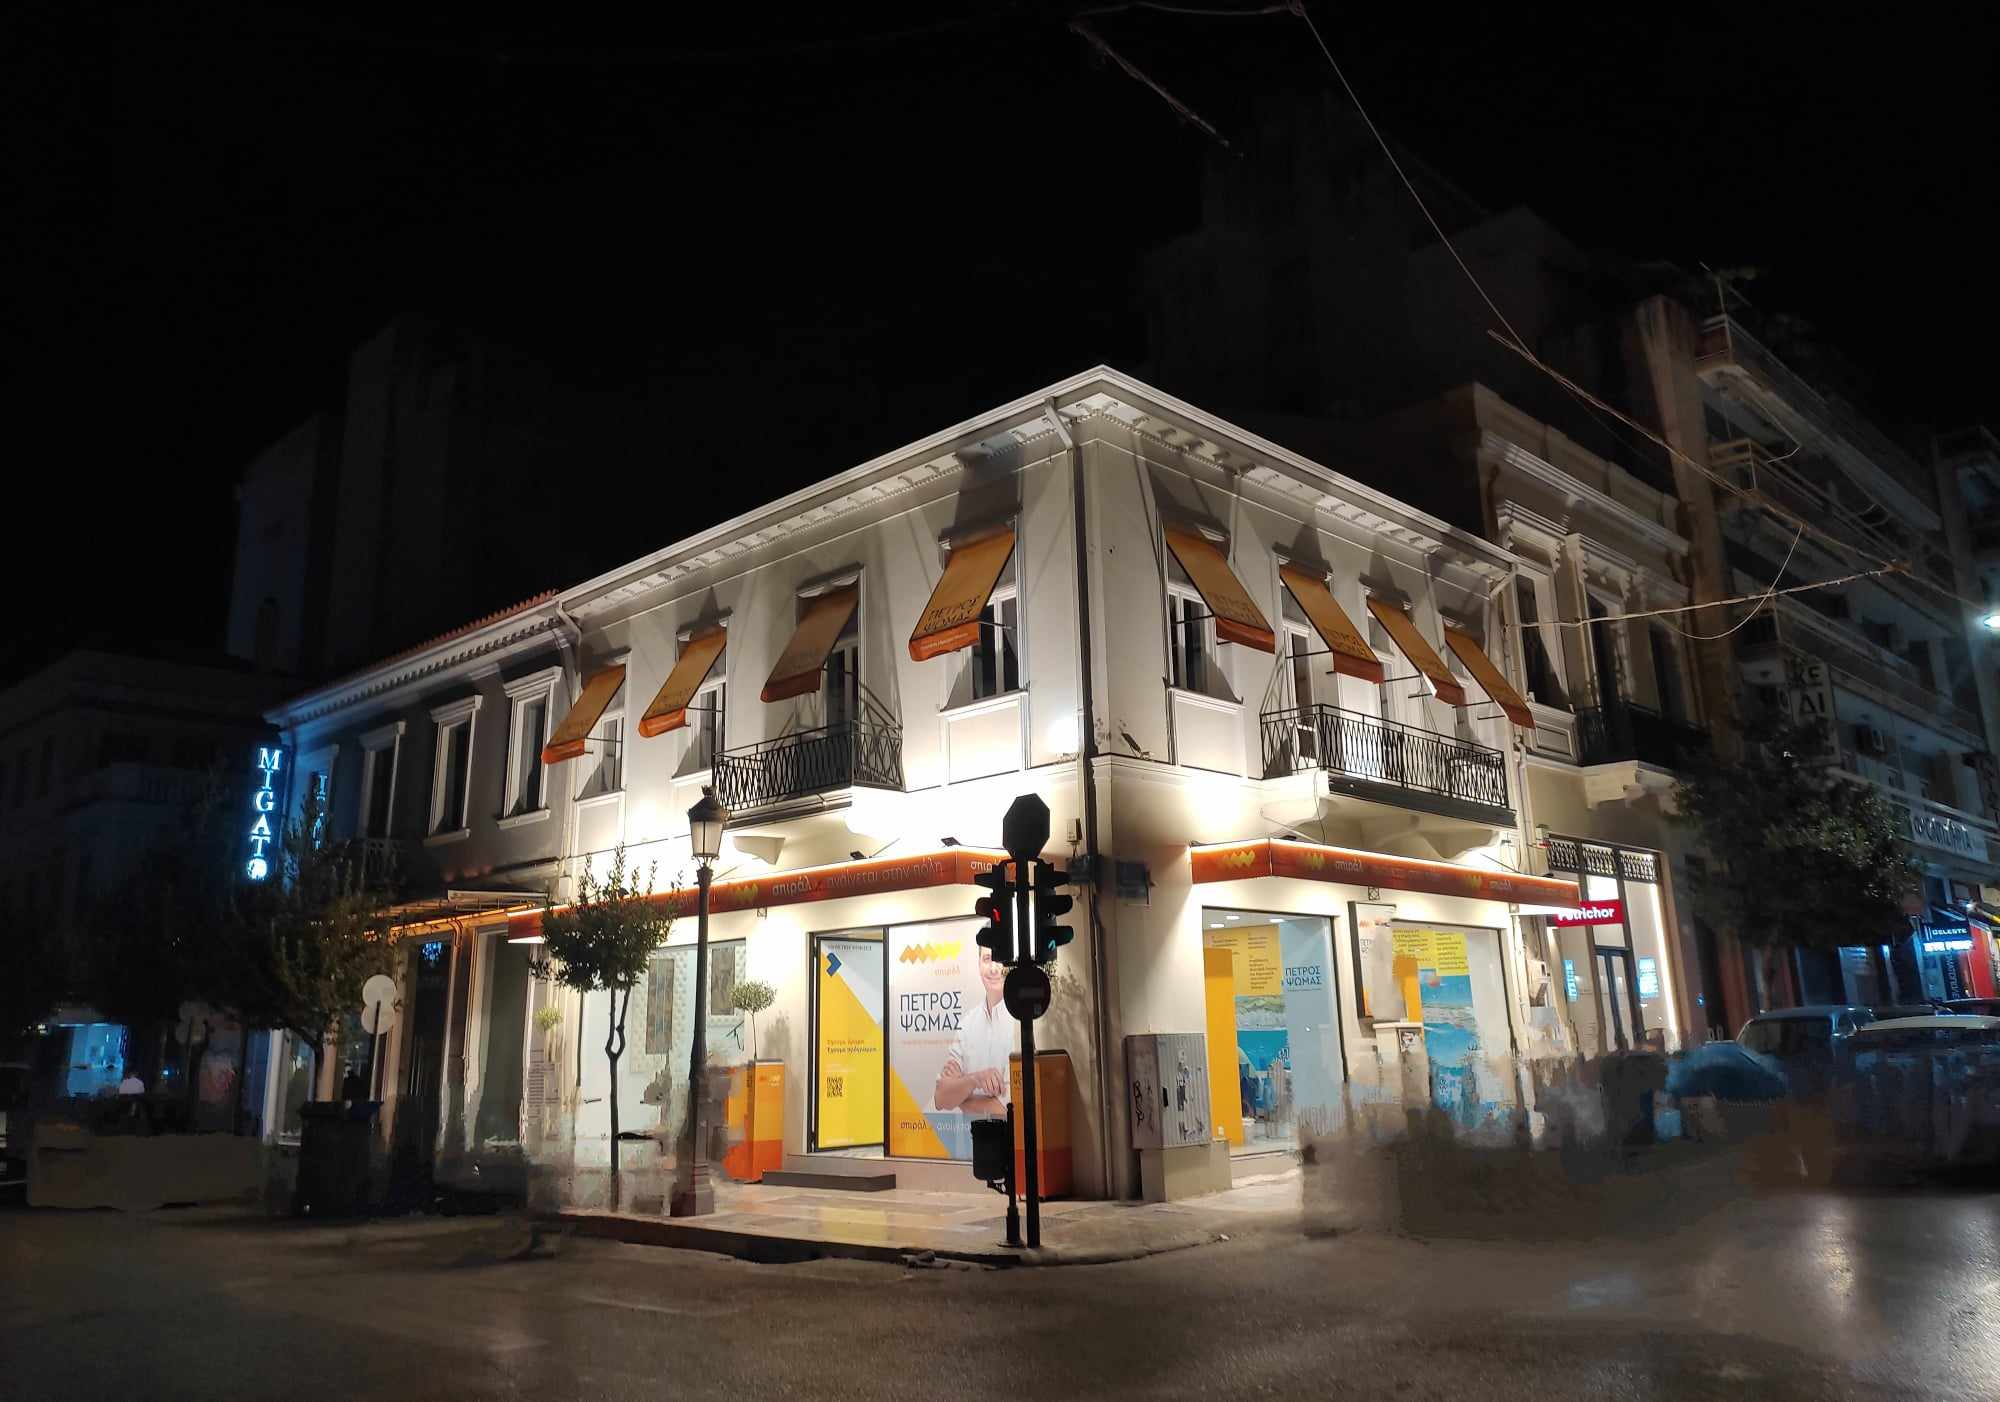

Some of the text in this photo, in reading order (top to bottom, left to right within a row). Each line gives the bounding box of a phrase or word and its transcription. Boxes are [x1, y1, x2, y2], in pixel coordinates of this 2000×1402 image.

[248, 748, 282, 880] MIGATO
[772, 875, 813, 897] σπιράλ
[1285, 966, 1321, 976] ΠΕΤΡΟΣ
[1286, 976, 1322, 986] ΨΩΜΑΣ
[900, 991, 962, 1011] ΠΕΤΡΟΣ
[900, 1012, 962, 1032] ΨΩΜΑΣ
[900, 1119, 928, 1132] σπιράλ
